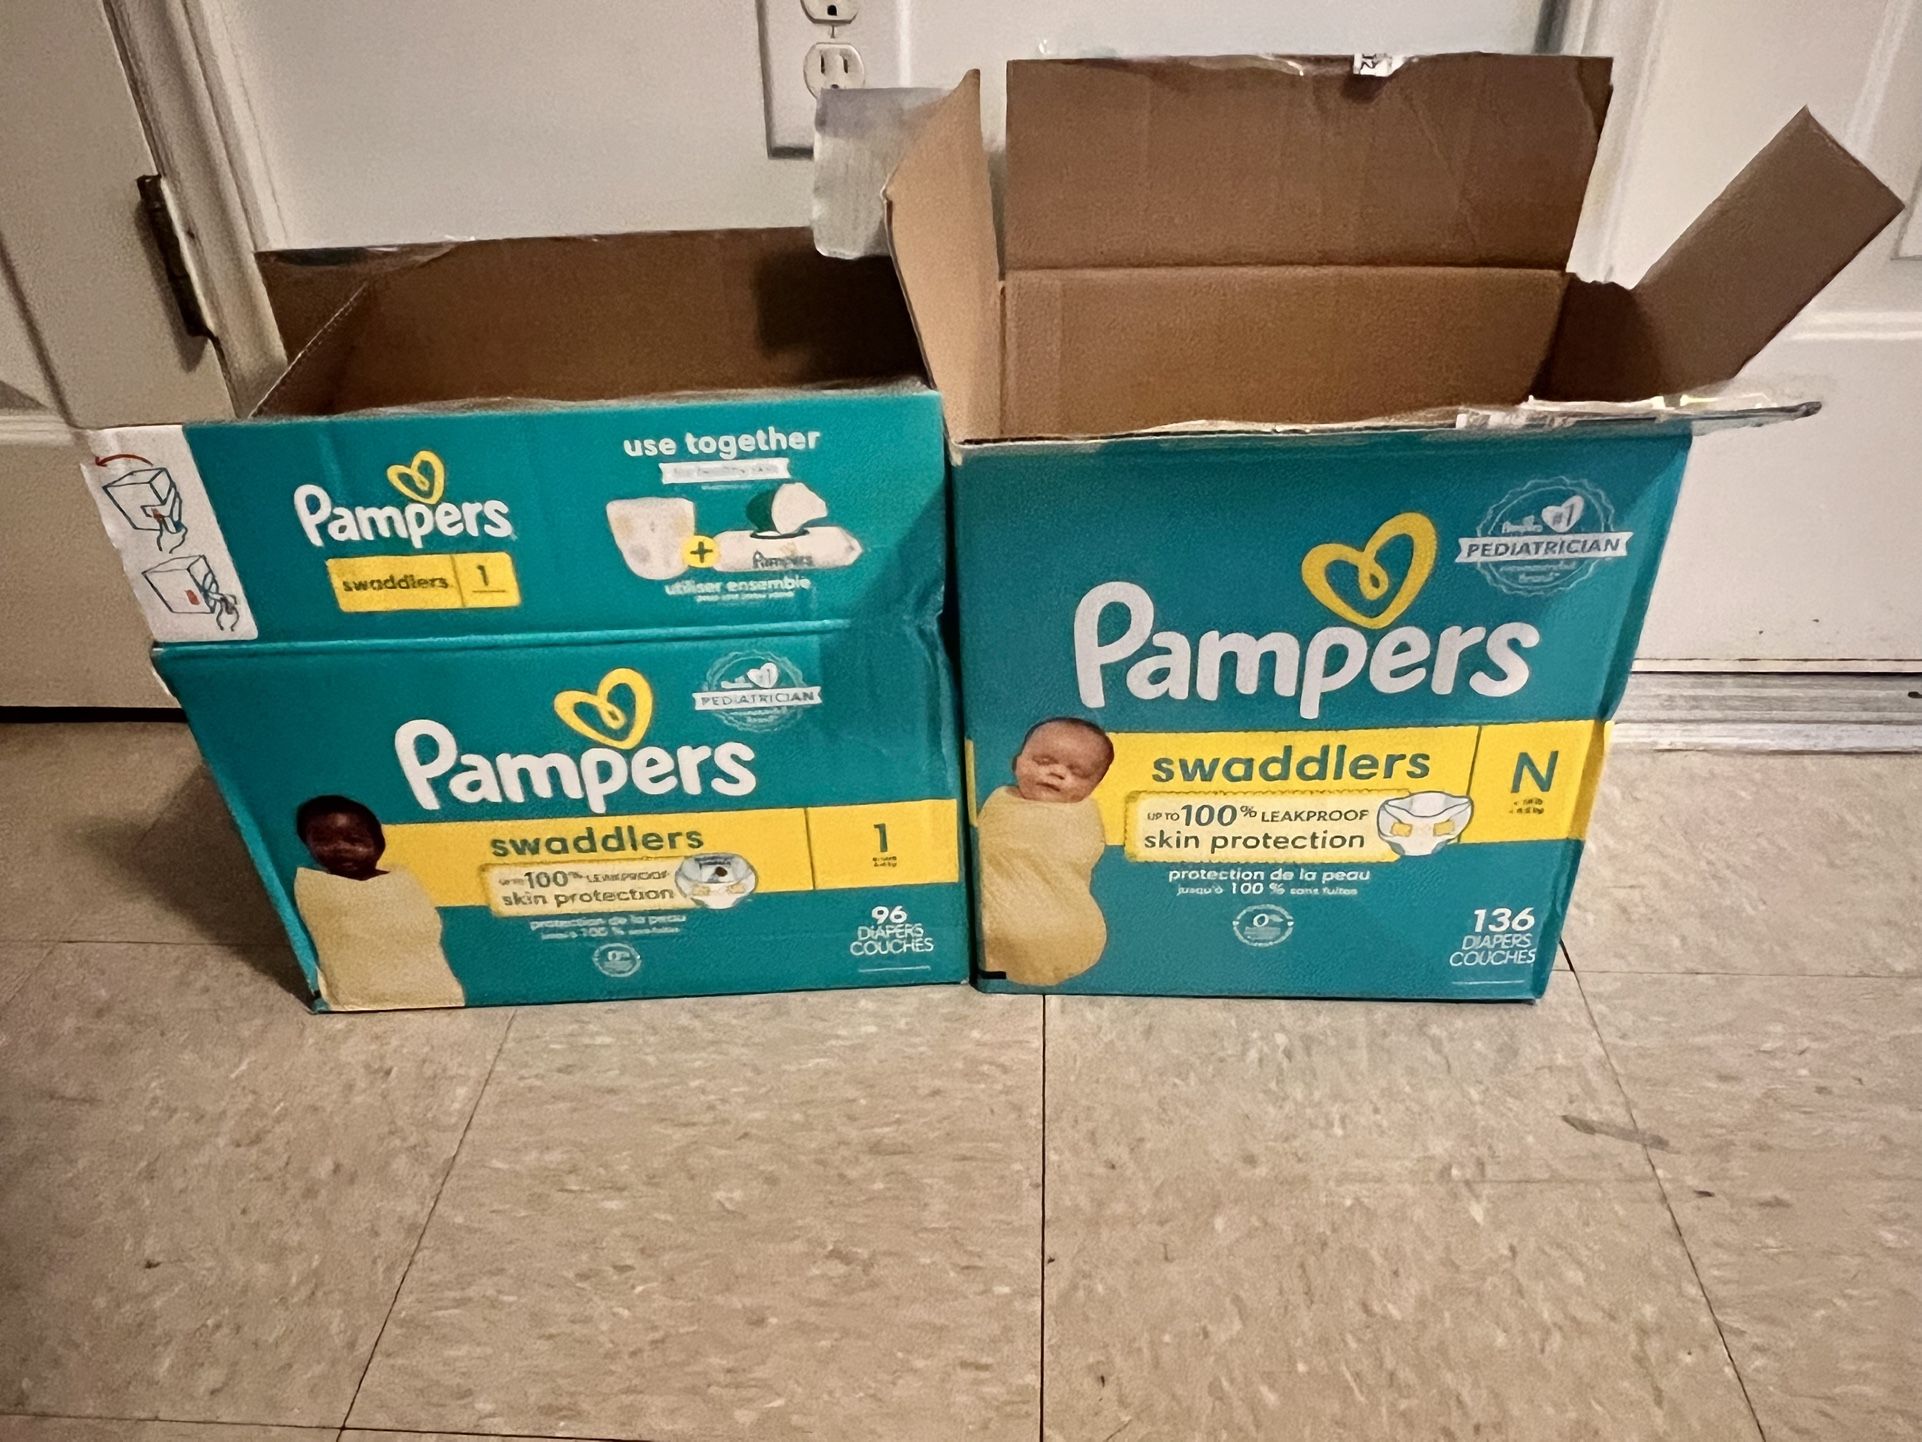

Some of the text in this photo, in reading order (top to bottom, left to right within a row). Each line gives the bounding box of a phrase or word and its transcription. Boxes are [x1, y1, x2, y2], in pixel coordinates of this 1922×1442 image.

[623, 426, 821, 460] use together
[293, 484, 514, 548] Pampers
[1466, 538, 1621, 558] PEDIATRICIAN
[342, 574, 449, 592] swaddlers
[476, 565, 490, 587] 1
[1074, 581, 1540, 720] Pampers
[700, 691, 816, 707] PEDIATRICIAN
[394, 719, 757, 814] Pampers
[1151, 744, 1431, 783] swaddlers
[1510, 750, 1559, 794] N
[1165, 811, 1180, 821] TO
[1260, 809, 1369, 823] LEAKPROOF
[491, 825, 705, 858] swaddlers
[873, 823, 889, 853] 1
[1144, 829, 1365, 855] skin protection
[1168, 867, 1371, 884] protection de la peau
[502, 888, 674, 908] skin protection
[1231, 882, 1264, 895] 100
[871, 905, 908, 924] 96
[1472, 907, 1536, 933] 136
[857, 923, 925, 941] DIAPERS
[1462, 933, 1533, 951] DIAPERS
[849, 937, 935, 956] COUCHES
[1449, 948, 1537, 967] COUCHES
